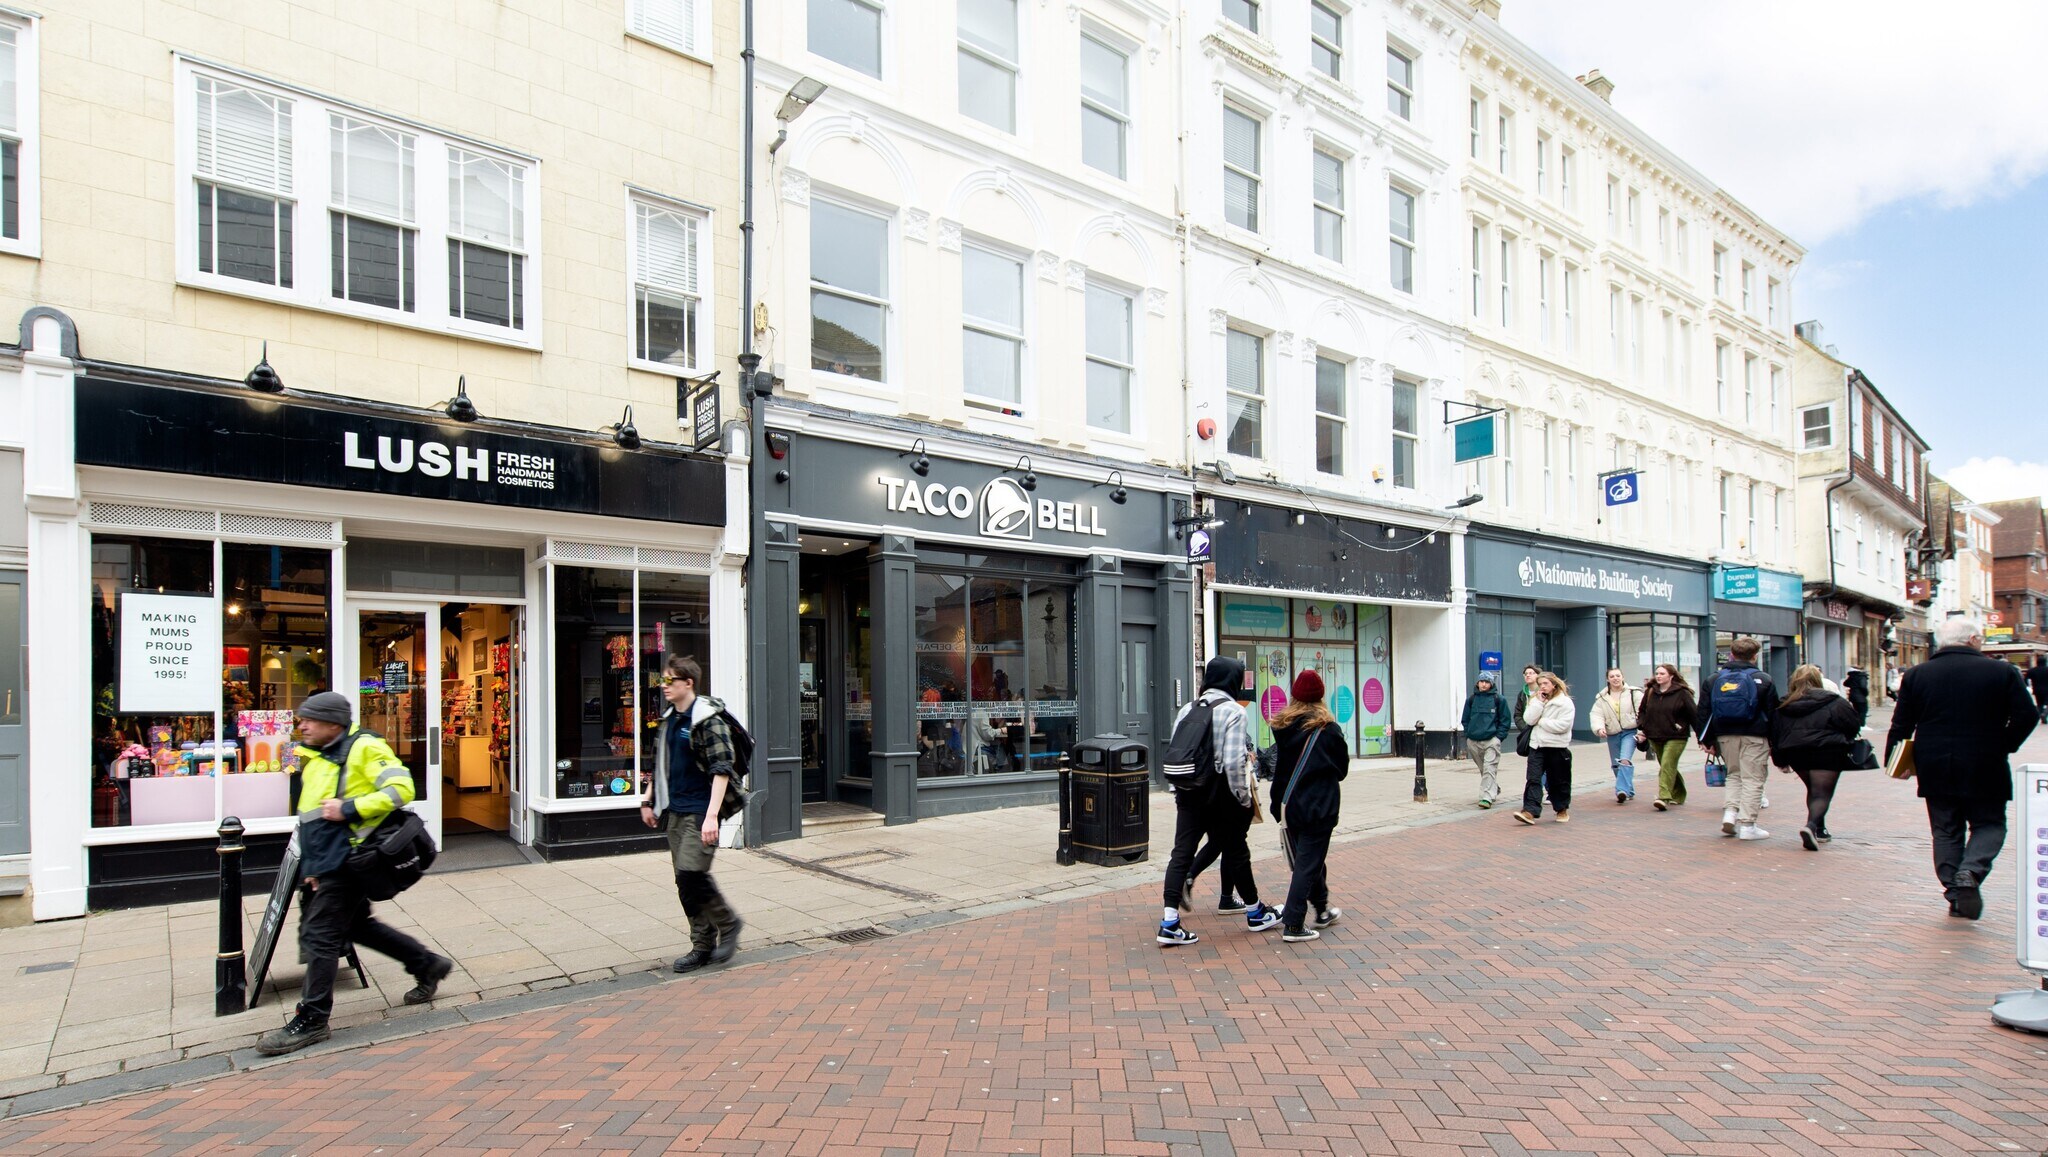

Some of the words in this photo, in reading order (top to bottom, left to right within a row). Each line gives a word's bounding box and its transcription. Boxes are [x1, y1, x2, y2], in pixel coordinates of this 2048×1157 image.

[697, 394, 715, 416] LUSH
[697, 407, 715, 428] FRESH
[344, 431, 489, 482] LUSH
[497, 451, 555, 471] FRESH
[497, 466, 555, 481] HANDMADE
[497, 475, 555, 490] COSMETICS
[878, 476, 974, 519] TACO
[1037, 498, 1107, 536] BELL
[1535, 560, 1597, 589] Nationwide
[1598, 569, 1640, 599] Building
[1641, 575, 1674, 602] Society
[1726, 573, 1755, 581] bureau
[1726, 586, 1756, 595] change
[1735, 580, 1747, 588] de
[141, 613, 197, 624] MAKING
[150, 627, 190, 638] MUMS
[145, 641, 193, 652] PROUD
[149, 655, 189, 666] SINCE
[154, 670, 187, 679] 1995!
